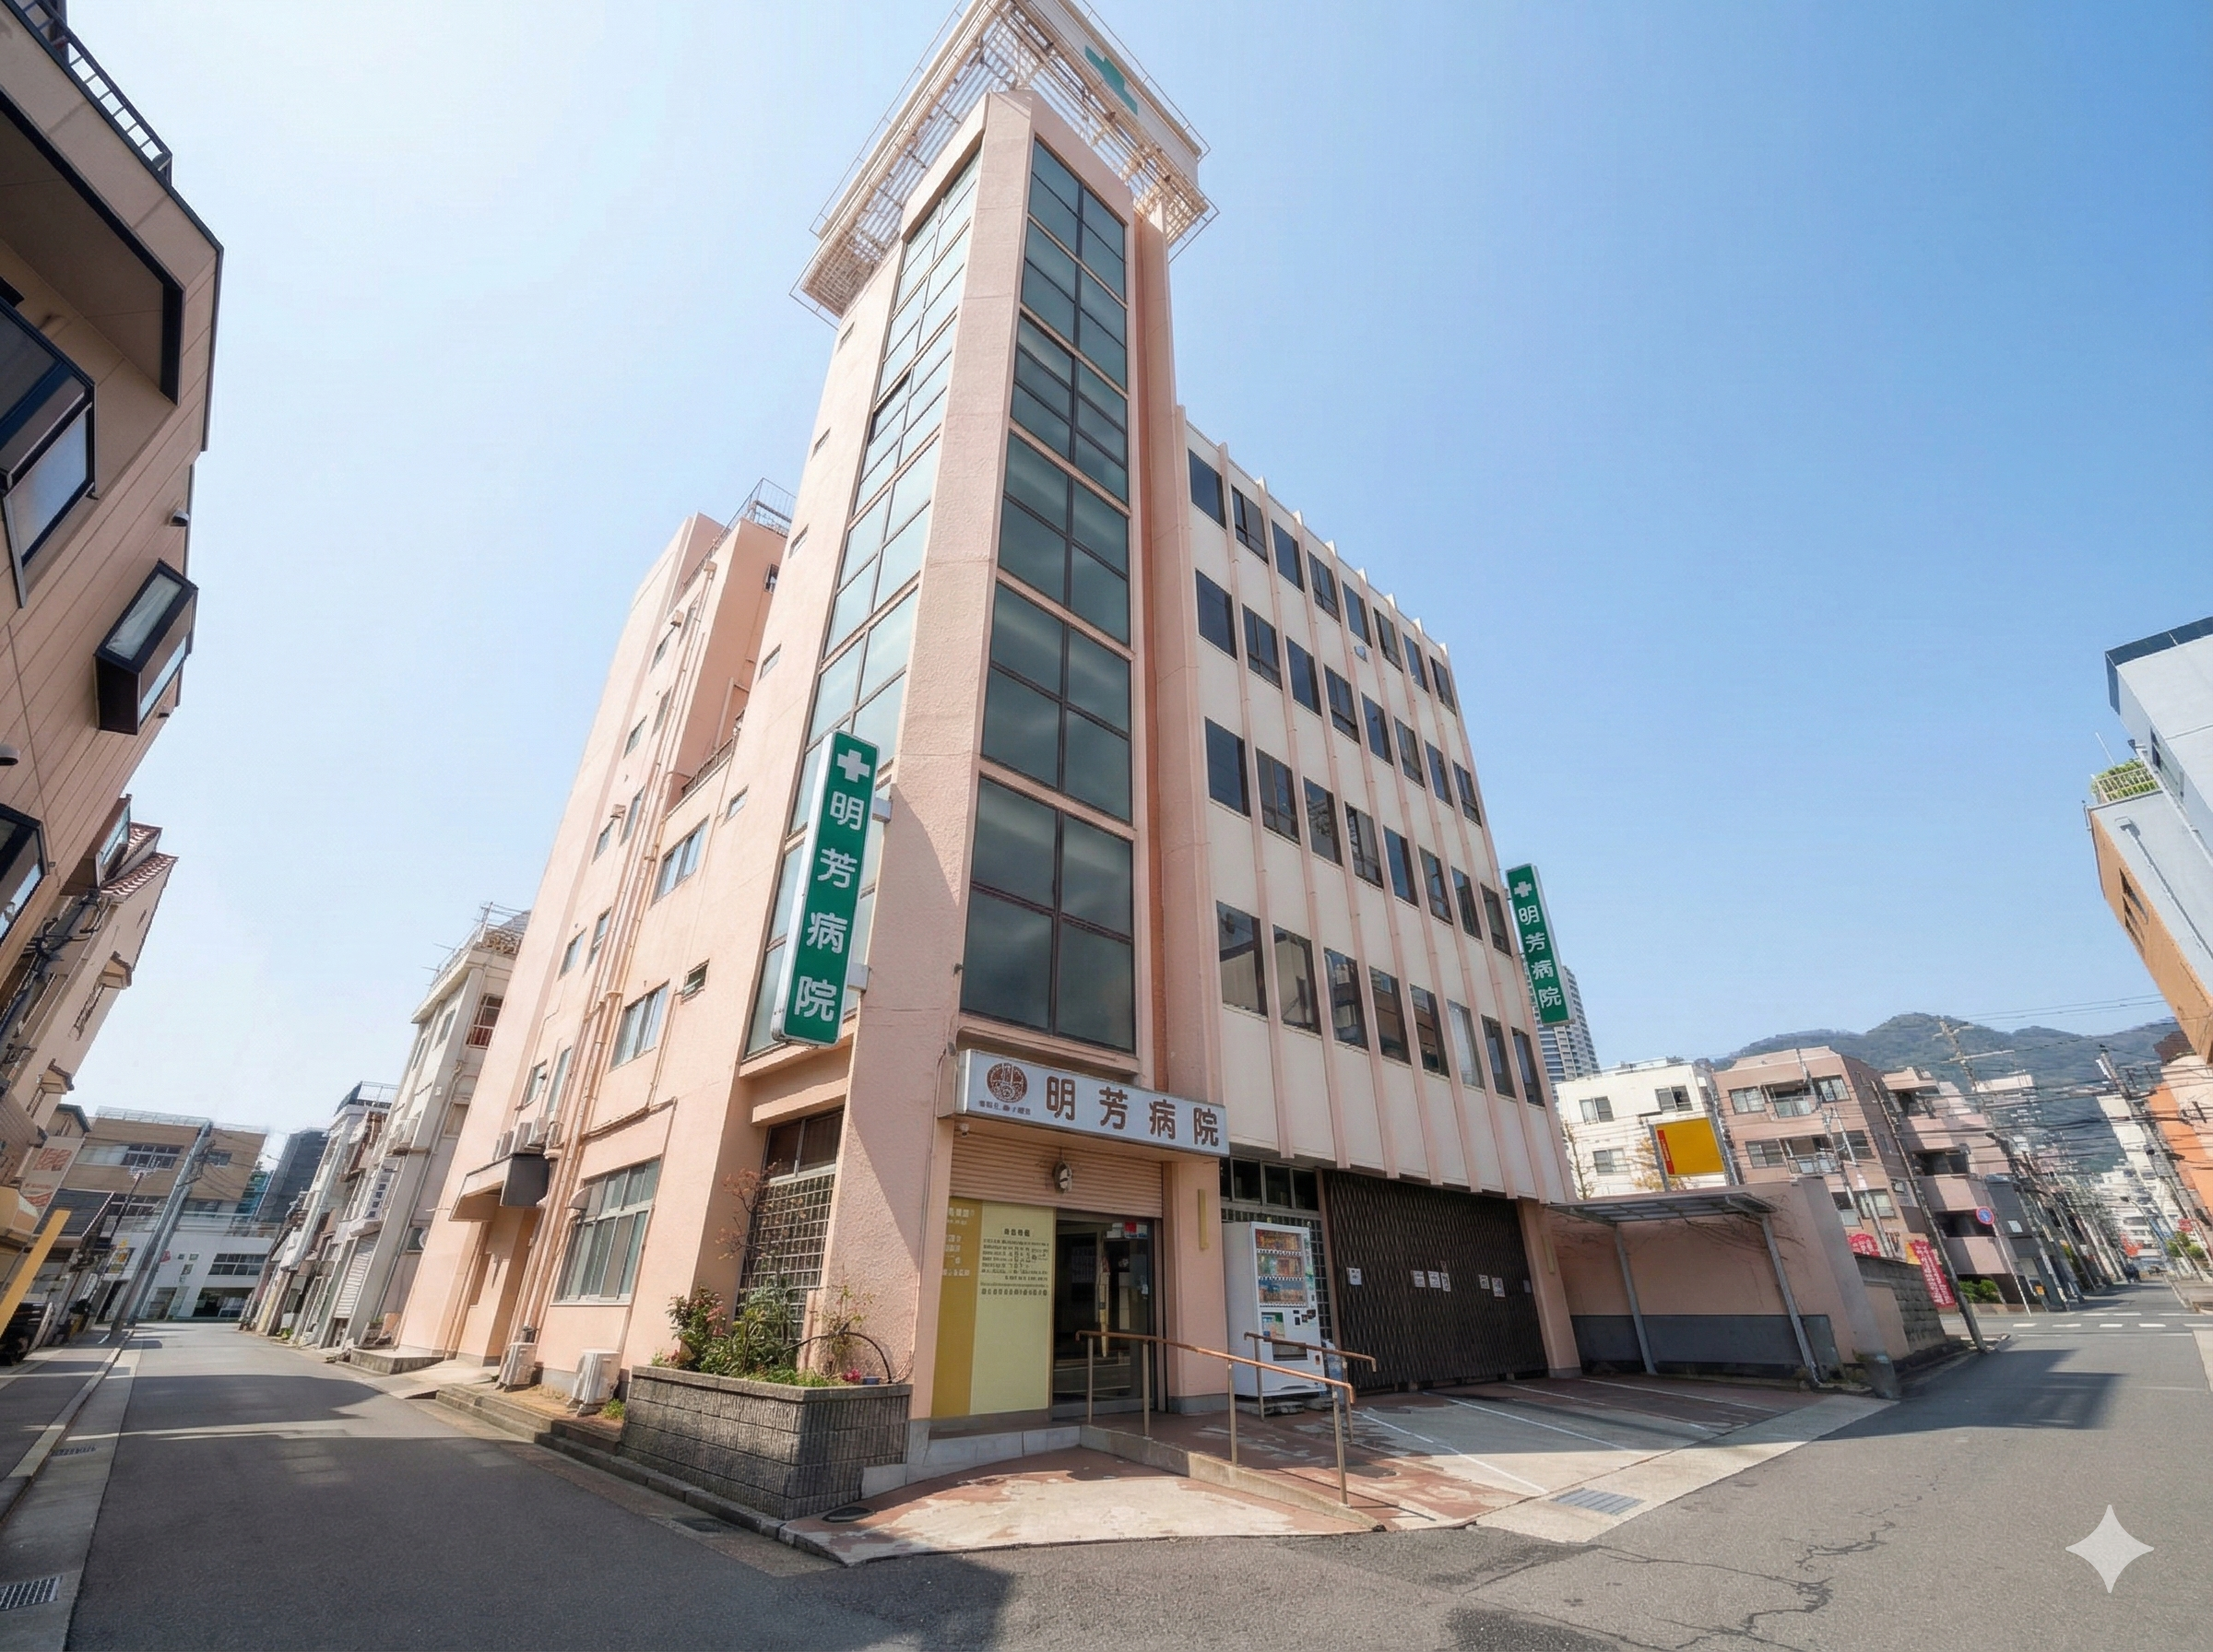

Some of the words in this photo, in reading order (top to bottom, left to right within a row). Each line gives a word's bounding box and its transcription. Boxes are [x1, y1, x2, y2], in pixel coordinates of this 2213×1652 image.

[794, 791, 865, 1022] 明芳病院
[1518, 904, 1562, 1009] 明芳病院
[1046, 1076, 1219, 1147] 明芳病院
